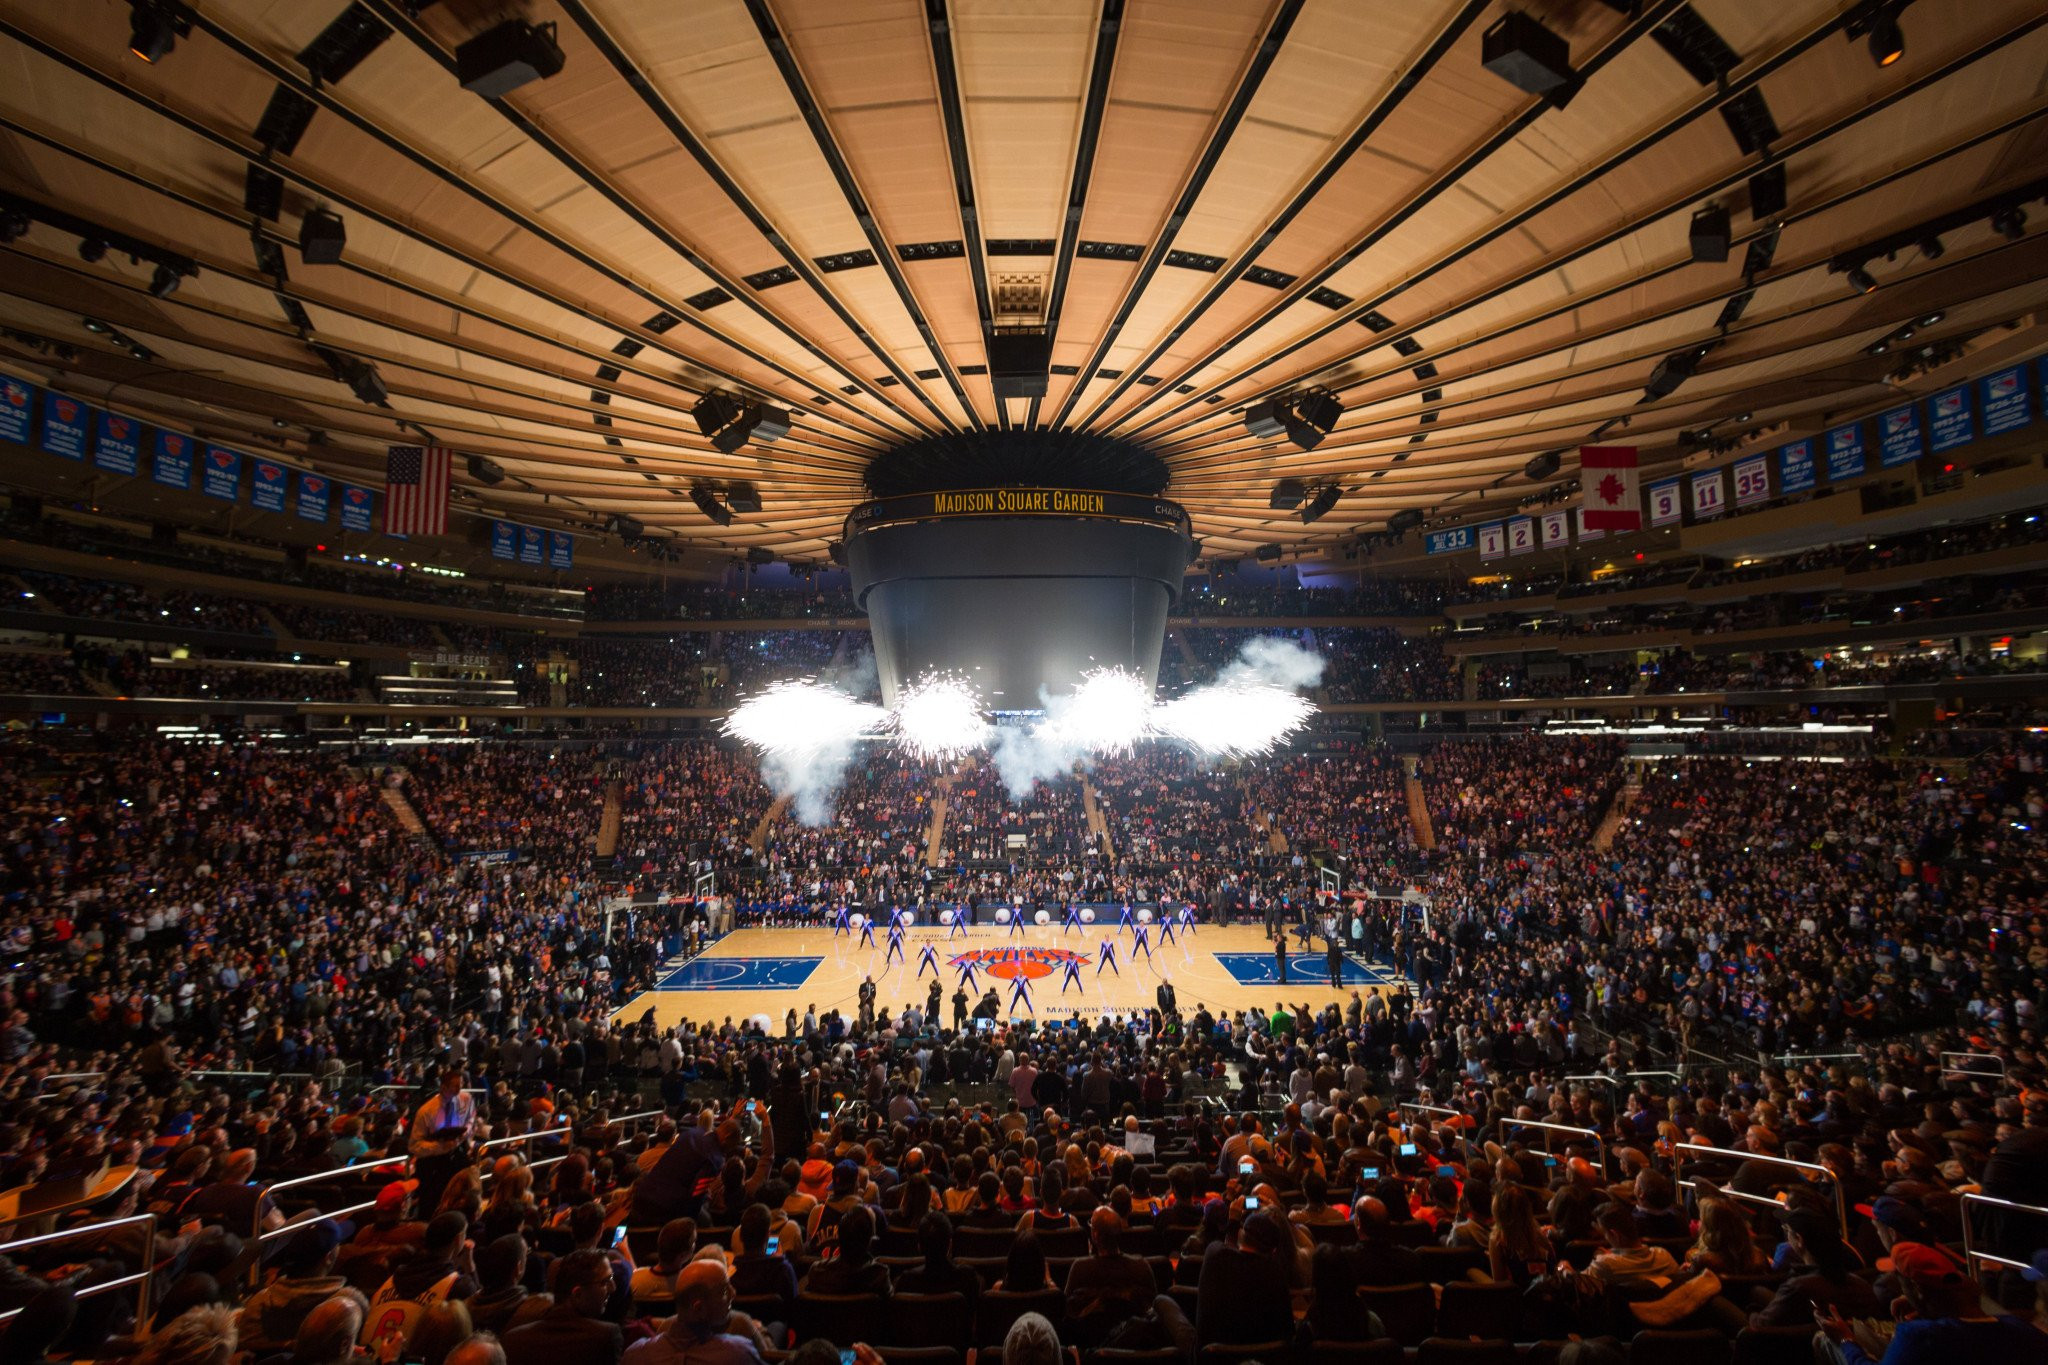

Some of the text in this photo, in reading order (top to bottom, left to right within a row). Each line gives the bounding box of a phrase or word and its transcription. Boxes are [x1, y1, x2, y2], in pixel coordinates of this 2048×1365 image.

[1737, 470, 1766, 496] 35
[935, 490, 1104, 513] MADISON SQUARE GARDEN
[1699, 485, 1717, 508] 11
[1155, 505, 1181, 519] CHASE
[1659, 496, 1672, 516] 9
[1433, 532, 1447, 543] BILLY
[1448, 529, 1467, 547] 33
[1516, 530, 1527, 547] 2
[1549, 522, 1561, 539] 3
[1434, 540, 1446, 550] JOEL
[1488, 536, 1496, 553] 1
[436, 653, 460, 665] BLUE
[463, 654, 490, 666] SEATS
